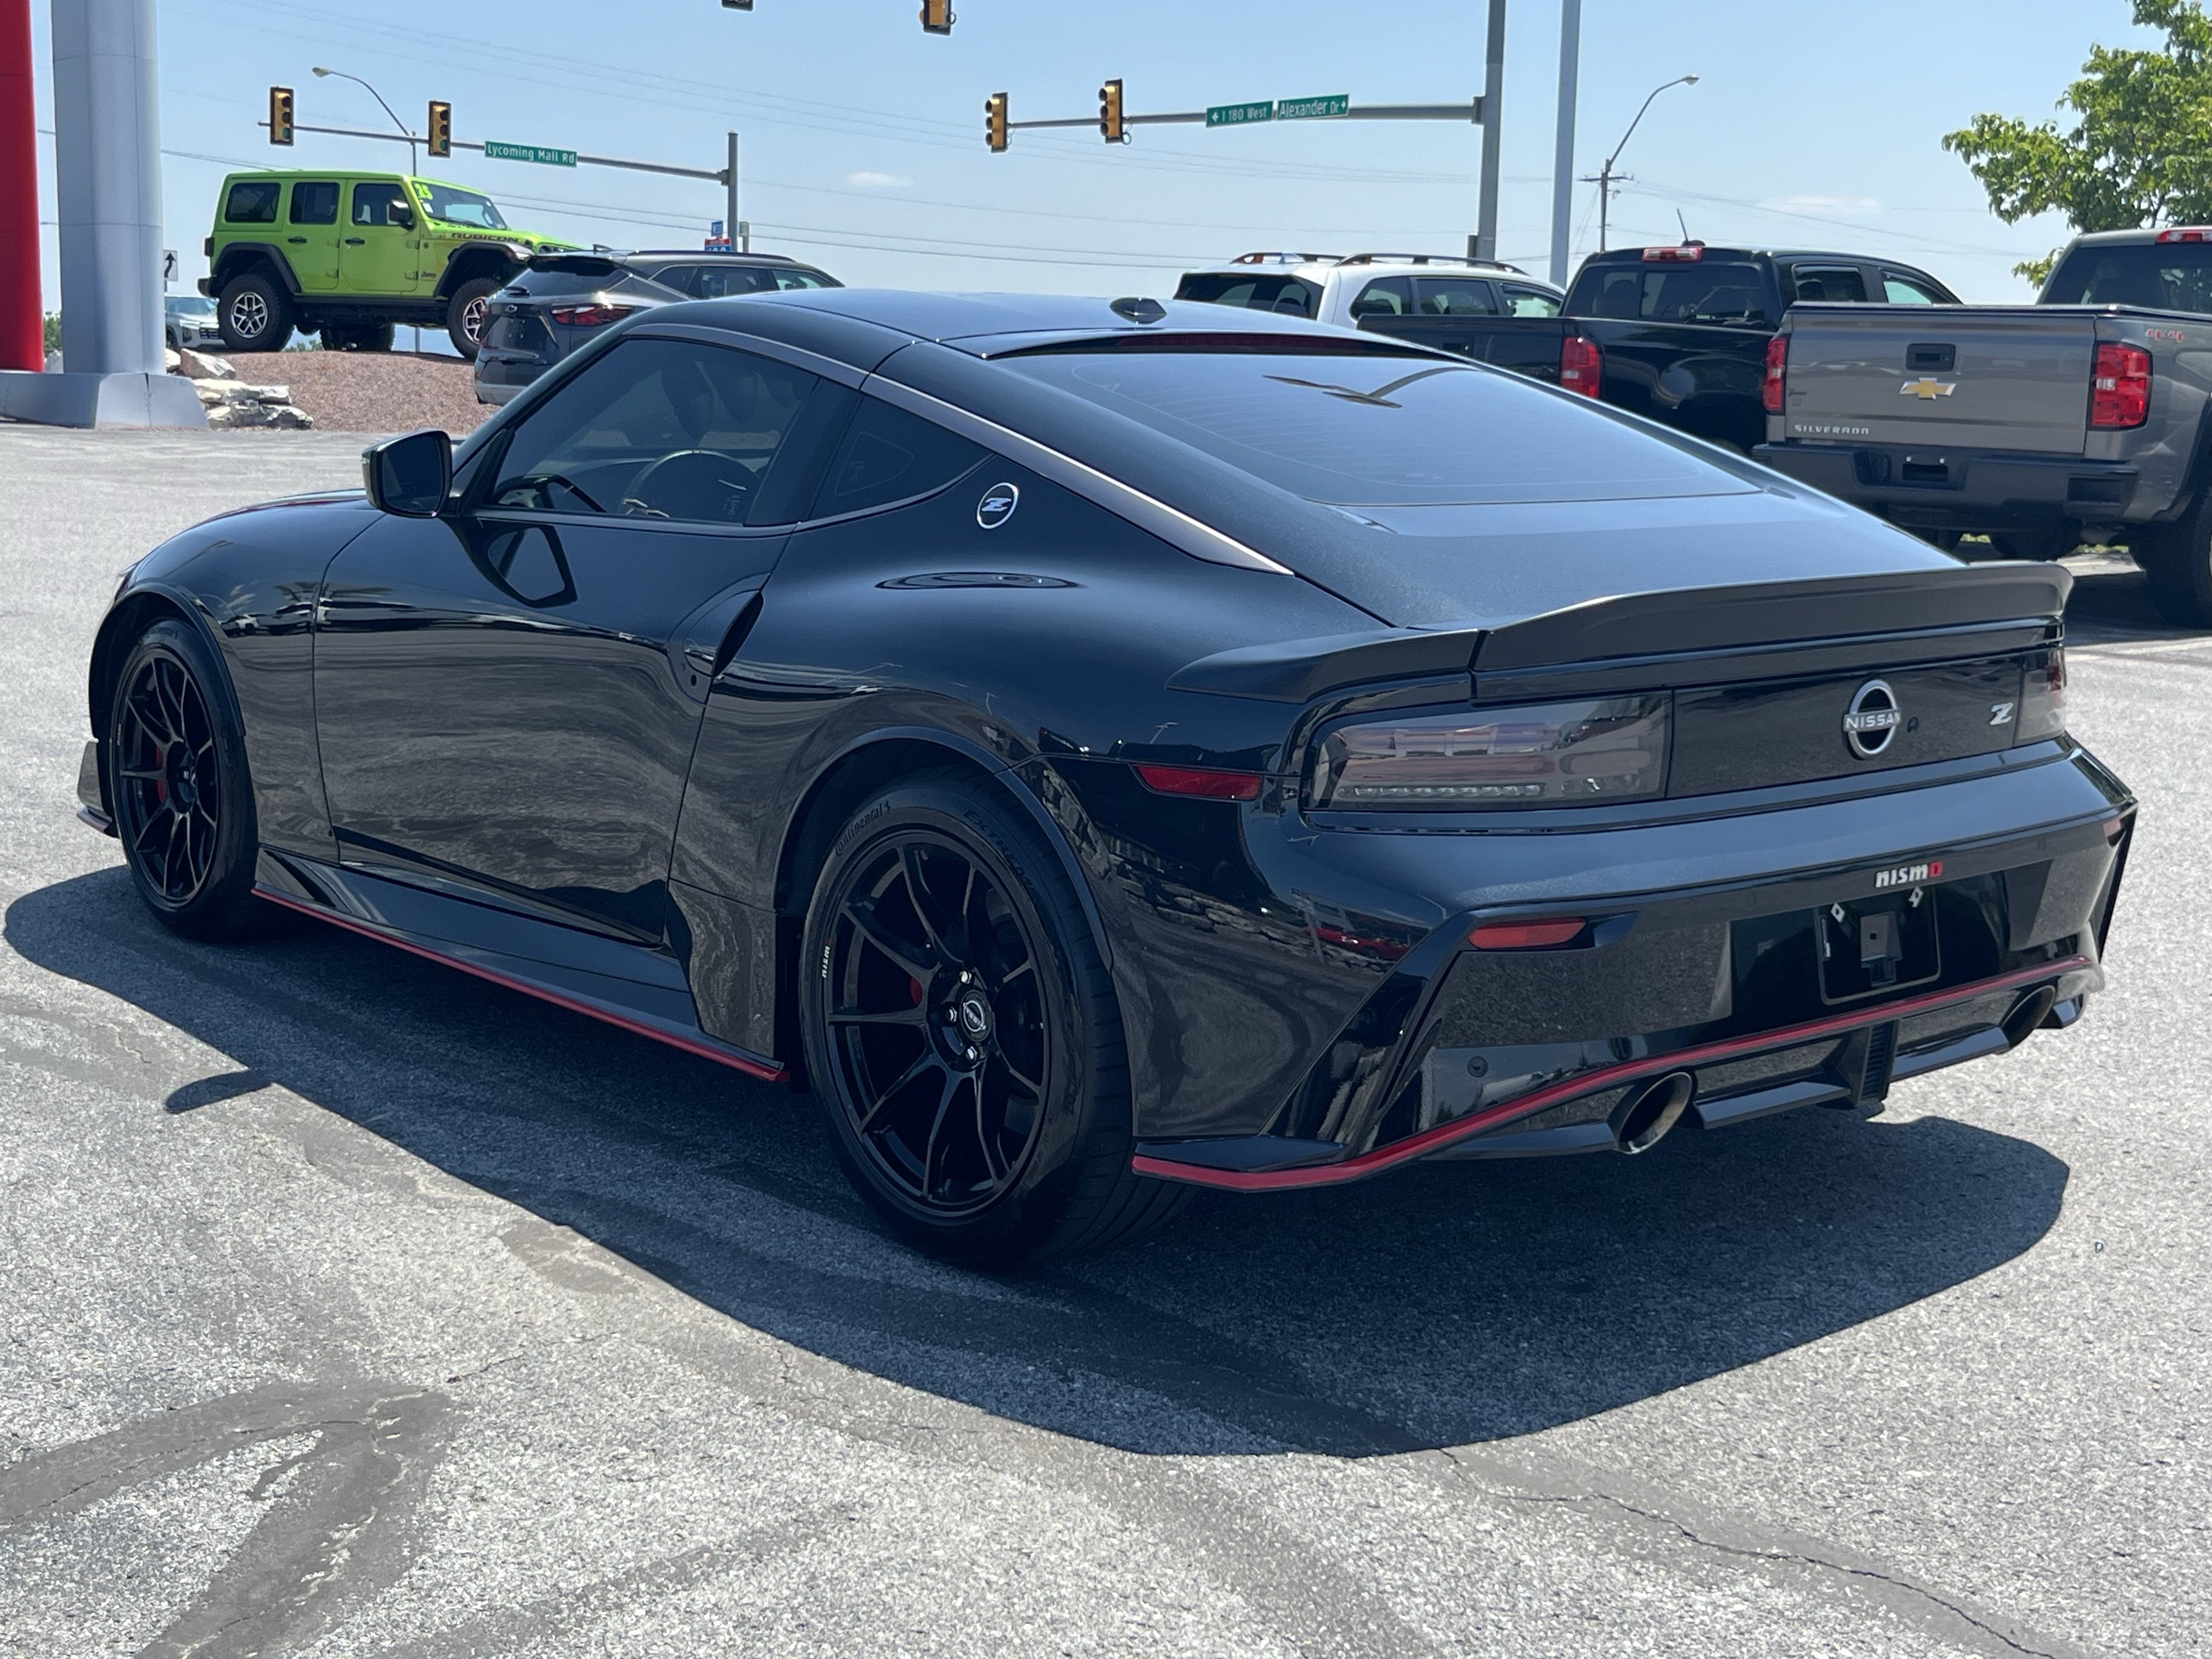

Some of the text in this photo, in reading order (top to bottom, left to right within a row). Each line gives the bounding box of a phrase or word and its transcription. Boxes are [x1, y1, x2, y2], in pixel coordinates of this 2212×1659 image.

[1229, 109, 1244, 121] 180
[1247, 106, 1267, 119] West
[1279, 99, 1340, 119] Alexander Dr
[487, 143, 574, 163] Lycoming Mall Rd
[452, 233, 519, 242] RUBICON
[1795, 424, 1869, 435] SILVERADO
[1989, 702, 2014, 725] Z
[835, 803, 883, 856] Continental
